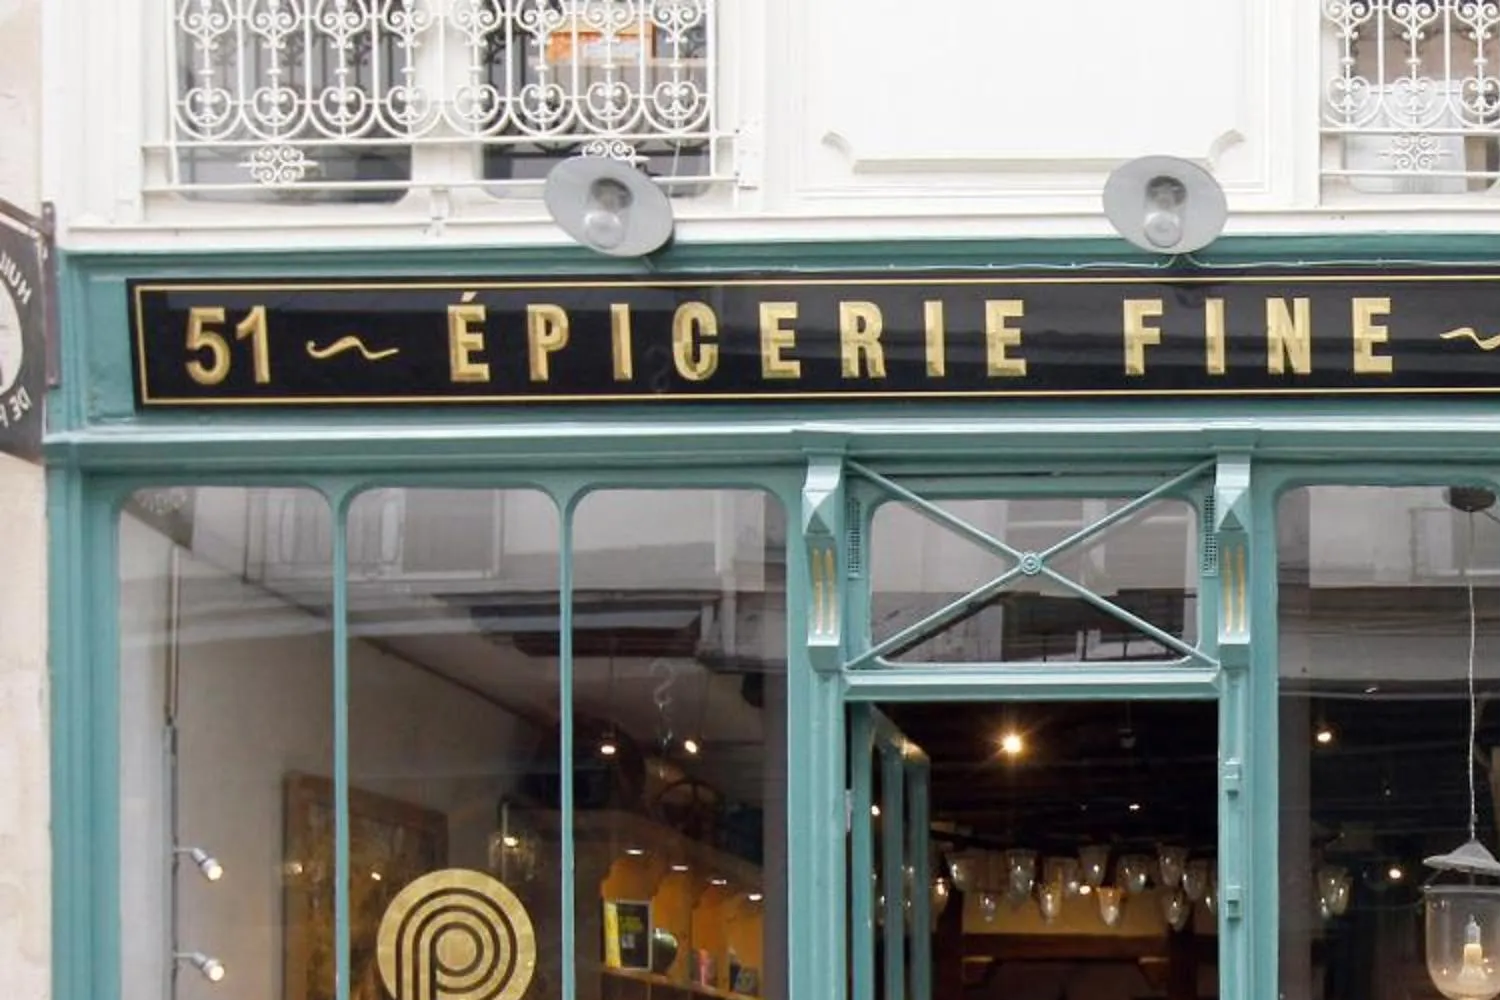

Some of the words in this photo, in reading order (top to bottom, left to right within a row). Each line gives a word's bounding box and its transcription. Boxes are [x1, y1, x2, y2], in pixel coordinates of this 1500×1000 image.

[185, 306, 272, 386] 51
[447, 291, 1027, 382] ÉPICERIE
[1122, 296, 1394, 376] FINE
